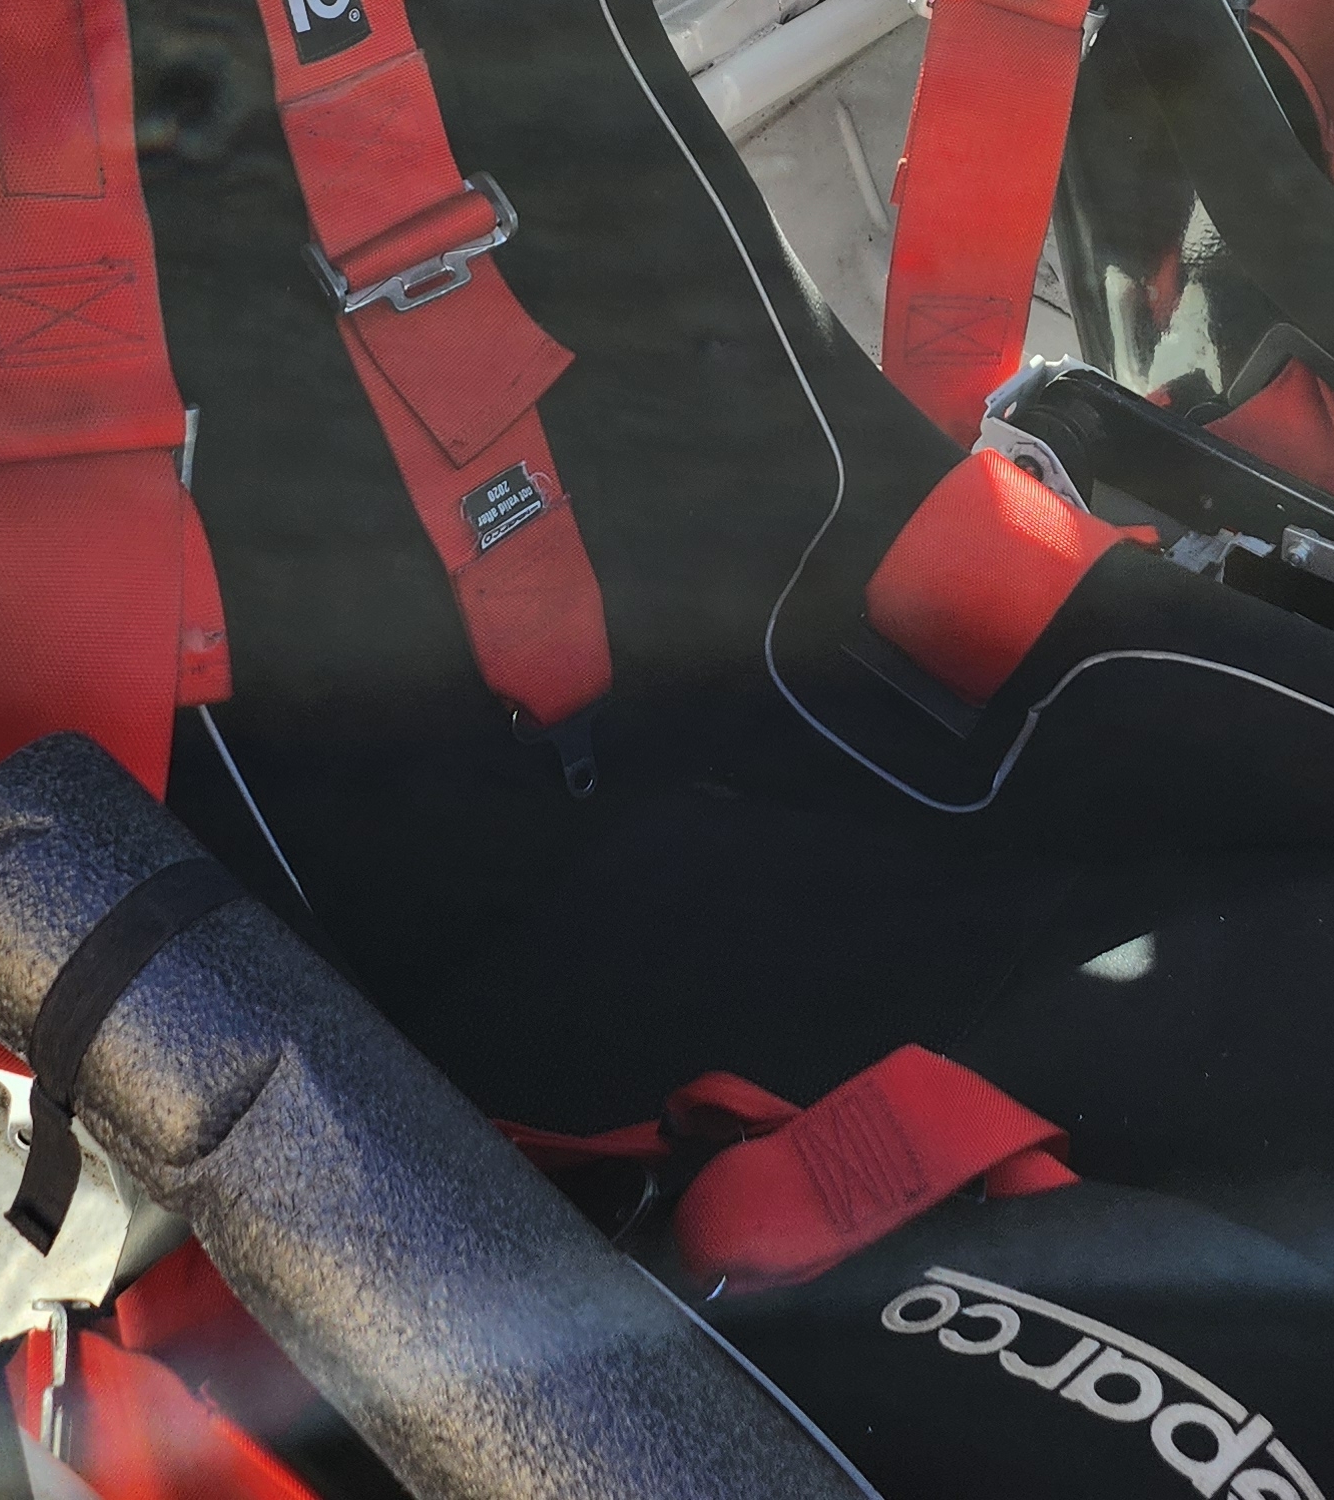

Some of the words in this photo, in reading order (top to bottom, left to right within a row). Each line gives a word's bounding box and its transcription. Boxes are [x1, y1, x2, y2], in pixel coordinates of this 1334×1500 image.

[487, 480, 510, 502] 2020
[518, 486, 534, 502] not
[498, 494, 520, 515] valid
[477, 507, 499, 527] after
